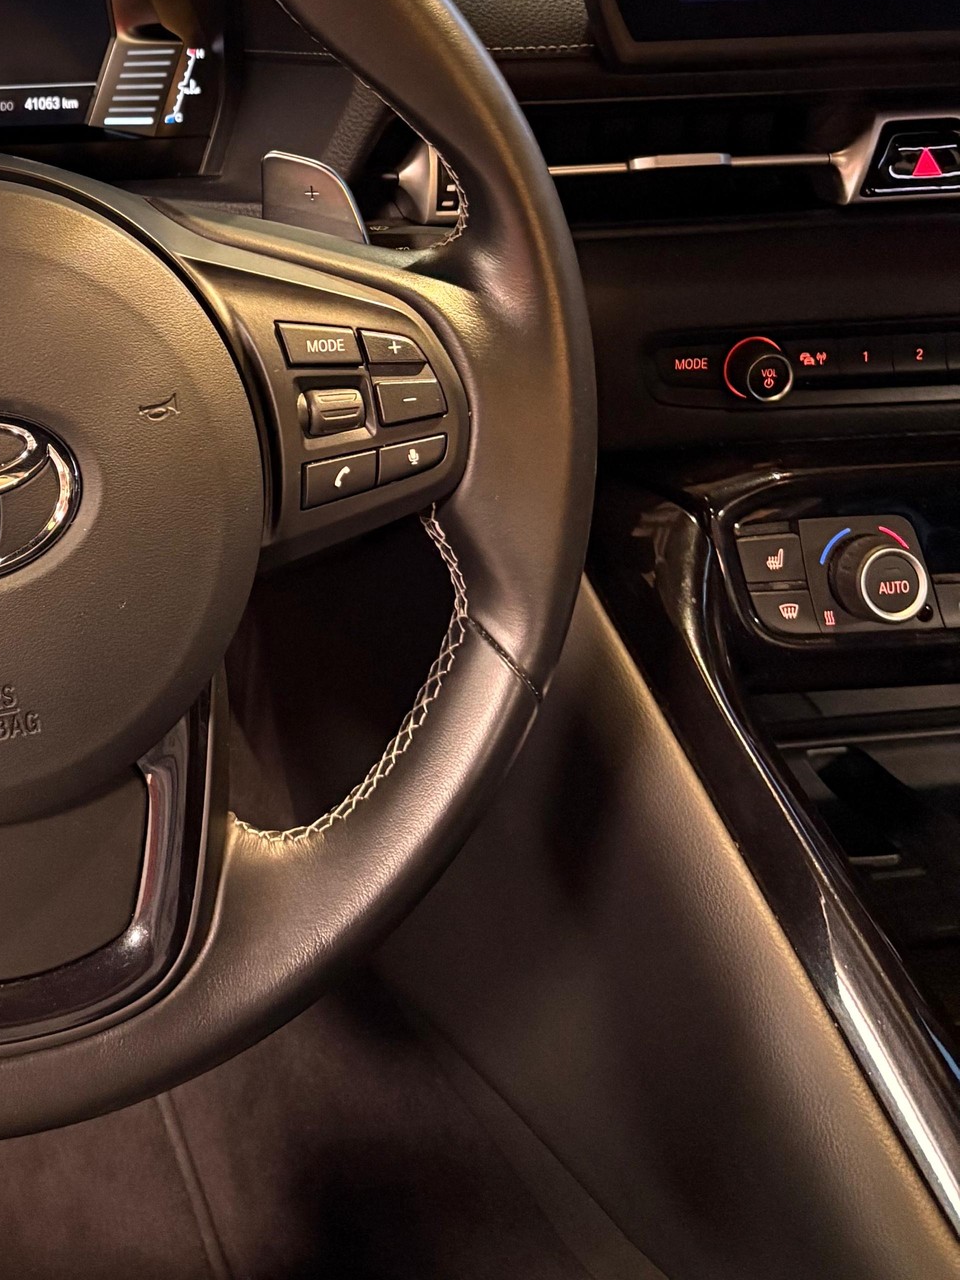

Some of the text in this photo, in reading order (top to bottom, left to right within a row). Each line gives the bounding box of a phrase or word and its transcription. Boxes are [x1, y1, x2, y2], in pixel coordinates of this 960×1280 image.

[24, 96, 60, 111] 41063
[61, 97, 79, 109] km
[306, 338, 346, 354] MODE
[863, 351, 869, 363] 1
[916, 348, 925, 361] 2
[675, 358, 709, 370] MODE
[761, 368, 777, 378] VOL
[878, 580, 910, 596] AUTO
